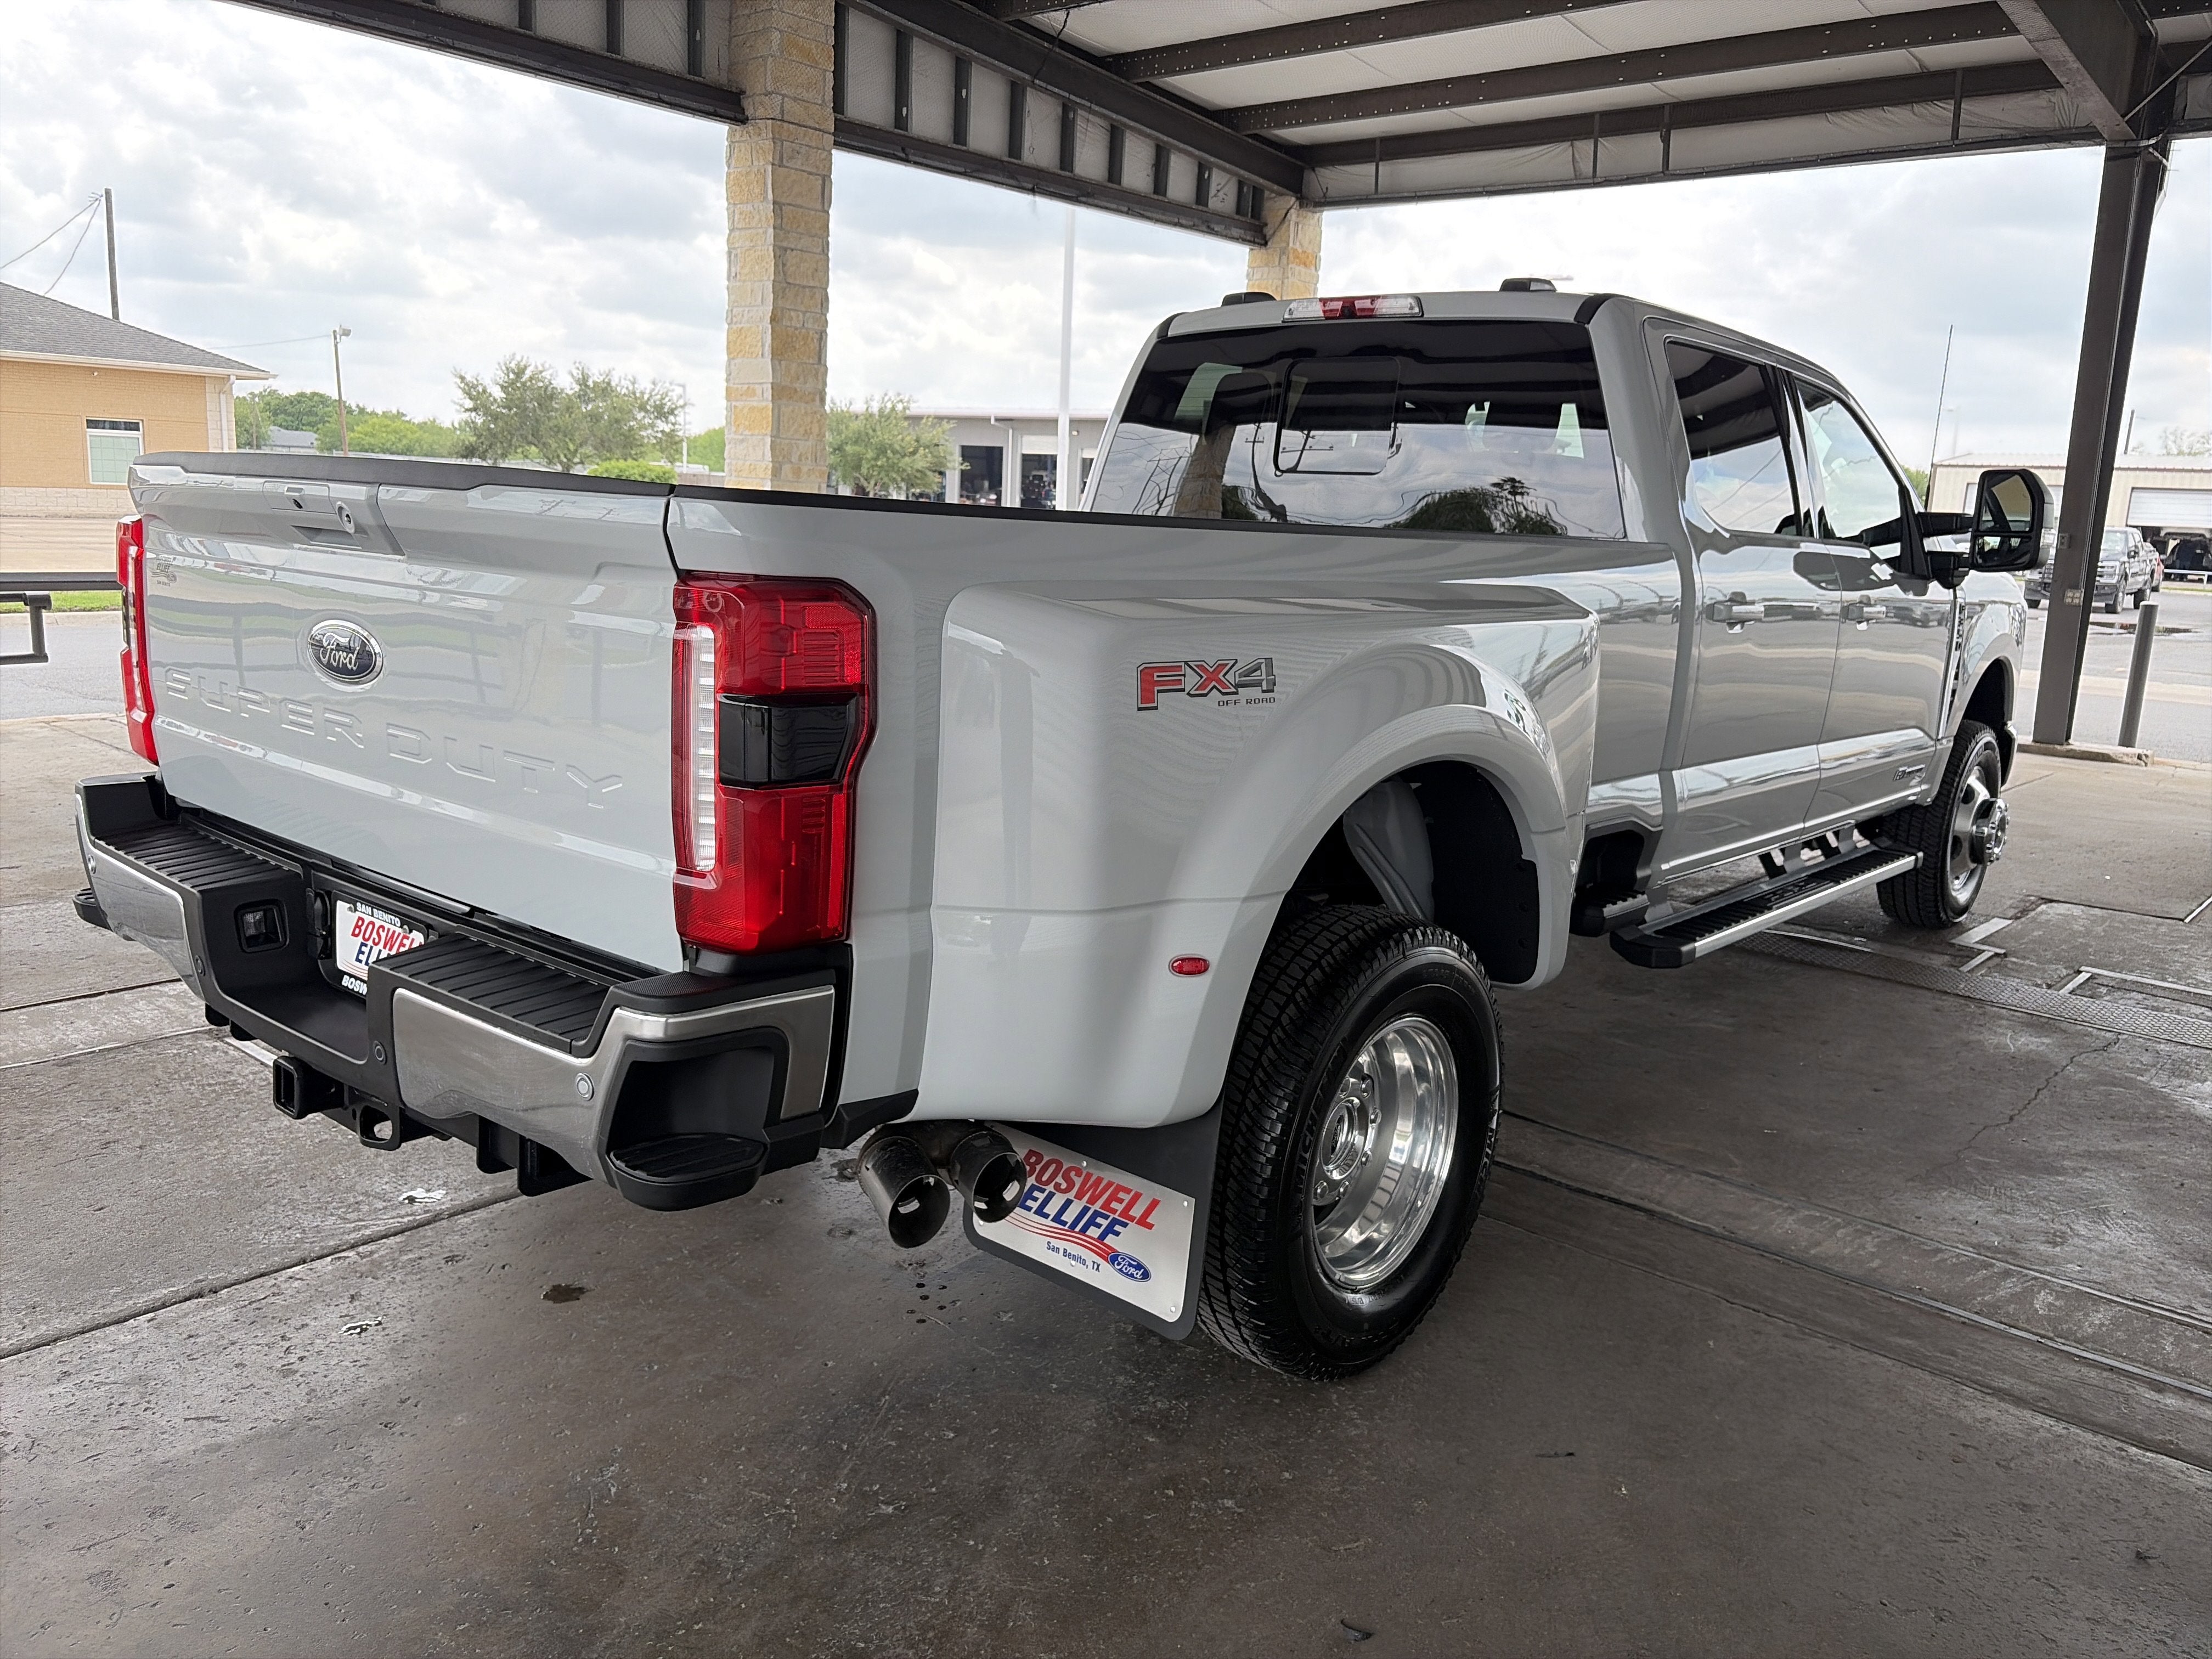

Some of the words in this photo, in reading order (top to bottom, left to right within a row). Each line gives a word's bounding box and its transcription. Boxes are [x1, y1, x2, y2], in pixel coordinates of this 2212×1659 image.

[319, 632, 359, 672] Ford
[1137, 657, 1276, 711] FX4
[1218, 698, 1241, 707] OFF
[1246, 697, 1276, 705] ROAD
[166, 667, 364, 748] SUPER
[386, 723, 623, 808] DUTY
[357, 902, 372, 916] SAN
[373, 908, 401, 927] BENITO
[351, 916, 422, 954] BOSWE
[1023, 1149, 1161, 1230] BOSWELL
[1018, 1183, 1130, 1242] ELLIFF
[1046, 1241, 1060, 1255] San
[1063, 1248, 1088, 1269] Benito,
[1091, 1260, 1102, 1273] TX
[1114, 1255, 1144, 1279] Ford
